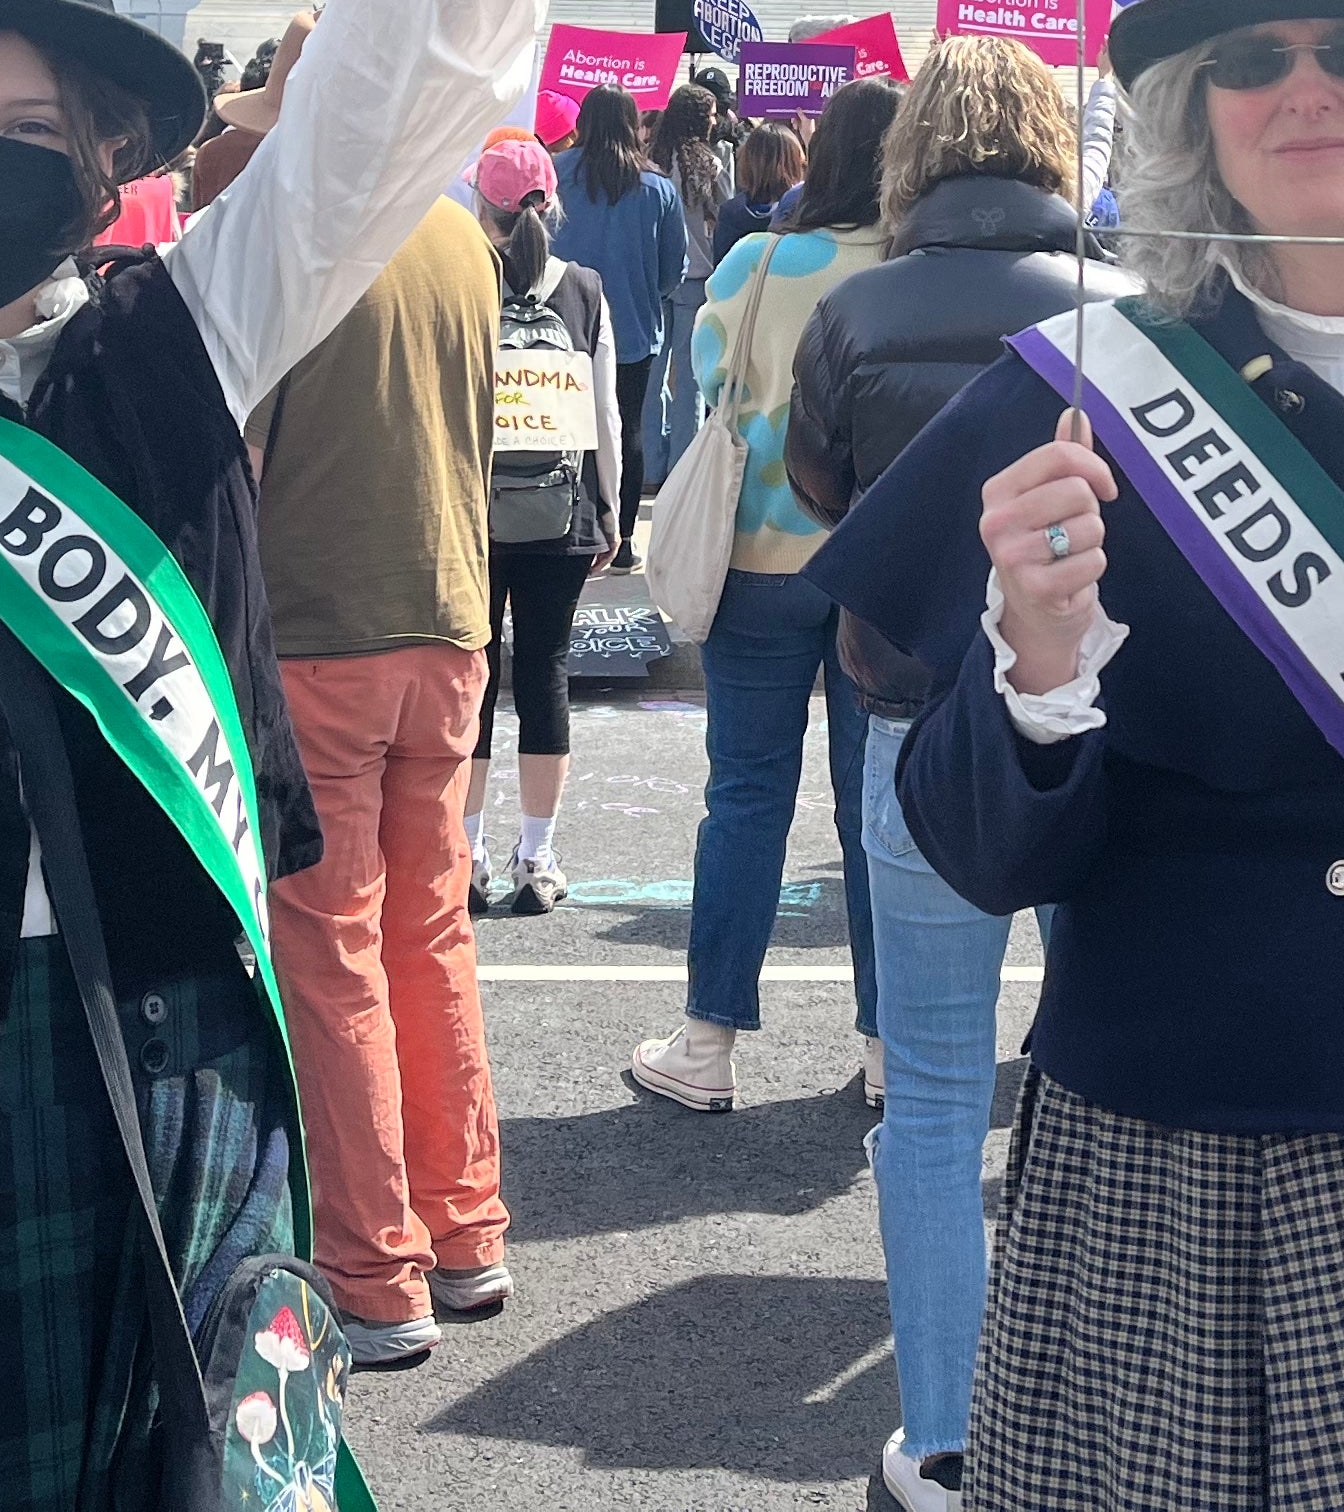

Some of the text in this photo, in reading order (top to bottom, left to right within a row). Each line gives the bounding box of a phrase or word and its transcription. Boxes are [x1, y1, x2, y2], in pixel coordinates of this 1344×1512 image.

[958, 4, 1085, 32] Health Care.
[563, 49, 645, 71] Abortion is
[858, 48, 867, 59] is
[560, 64, 660, 86] Health Care.
[745, 63, 847, 83] REPRODUCTIVE
[745, 79, 809, 96] FREEDOM
[495, 369, 582, 391] ANDMA
[495, 415, 558, 430] OICE
[1129, 388, 1333, 609] DEEDS
